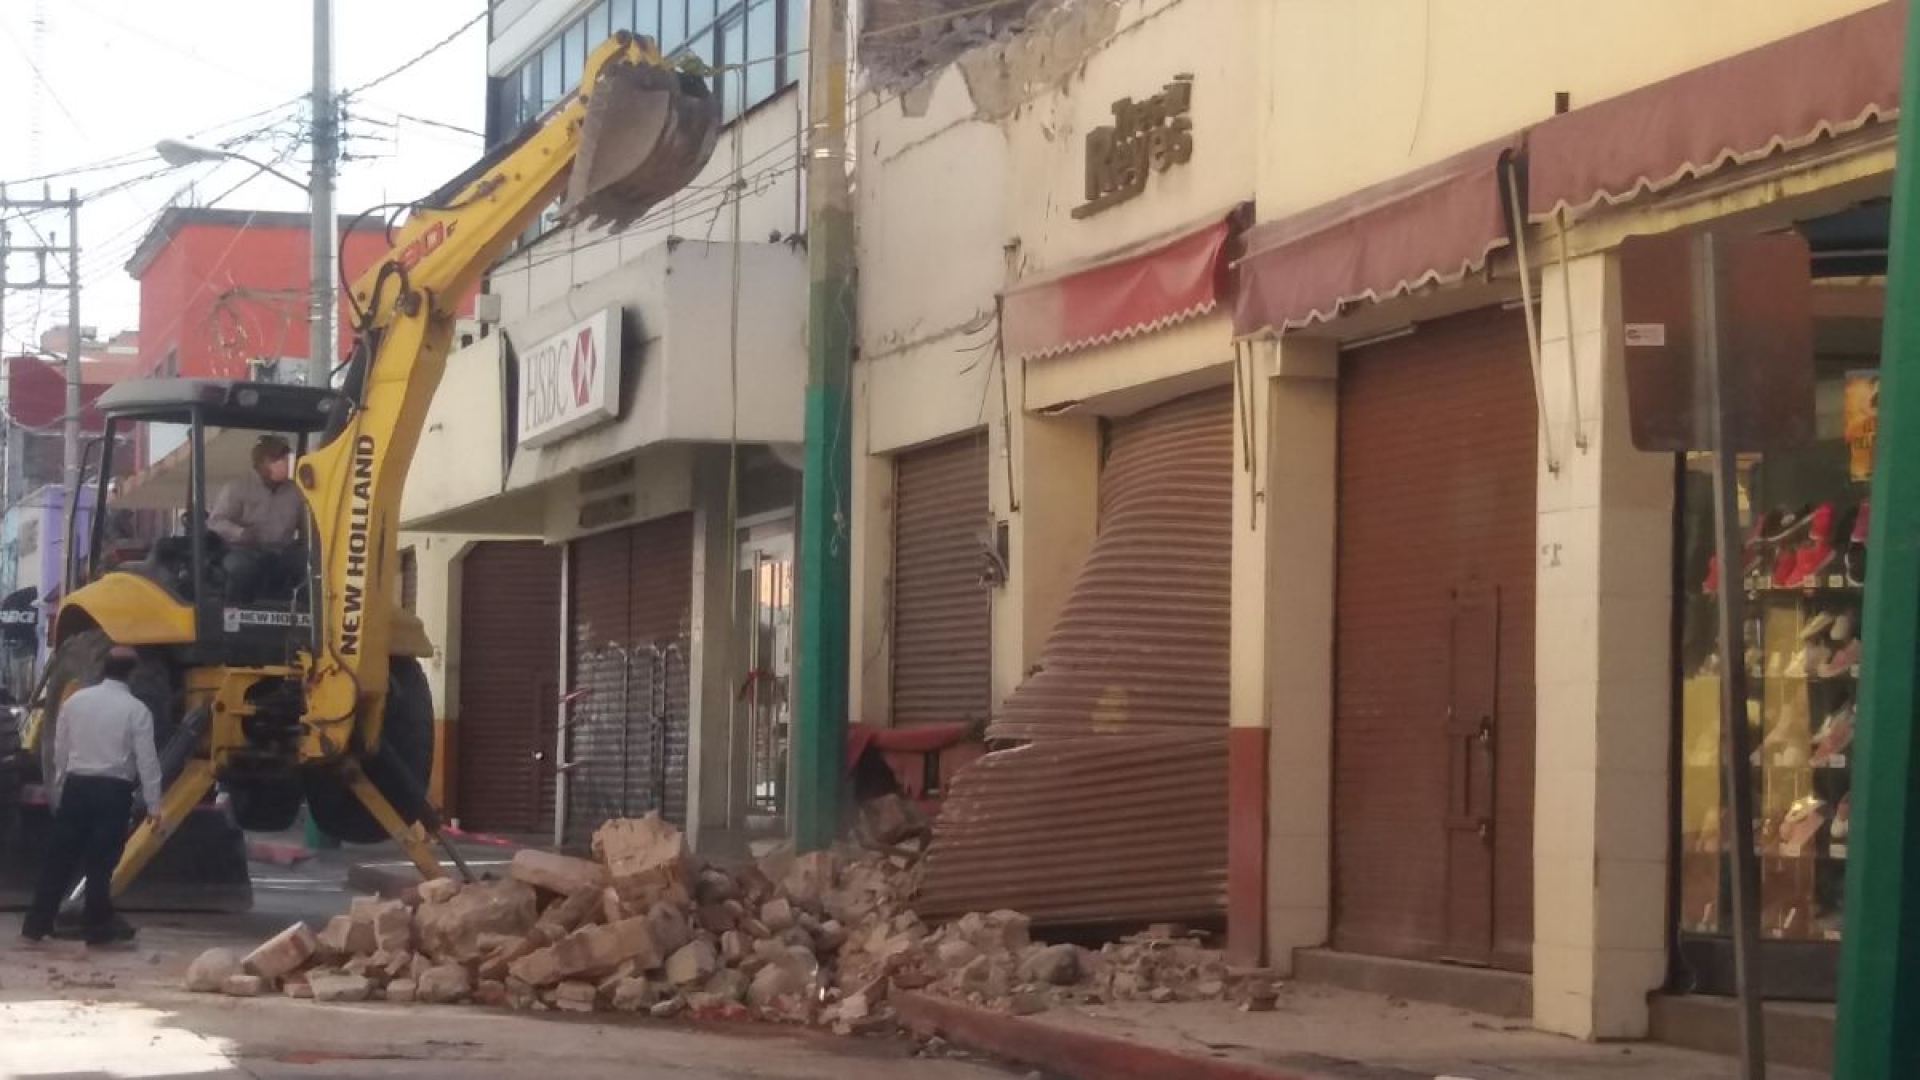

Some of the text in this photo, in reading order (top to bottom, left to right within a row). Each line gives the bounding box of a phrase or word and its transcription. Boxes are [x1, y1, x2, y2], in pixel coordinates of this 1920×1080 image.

[1072, 116, 1193, 218] Reyes
[524, 338, 569, 433] HSBC
[340, 434, 375, 655] NEW HOLLAND
[239, 611, 269, 624] NEW
